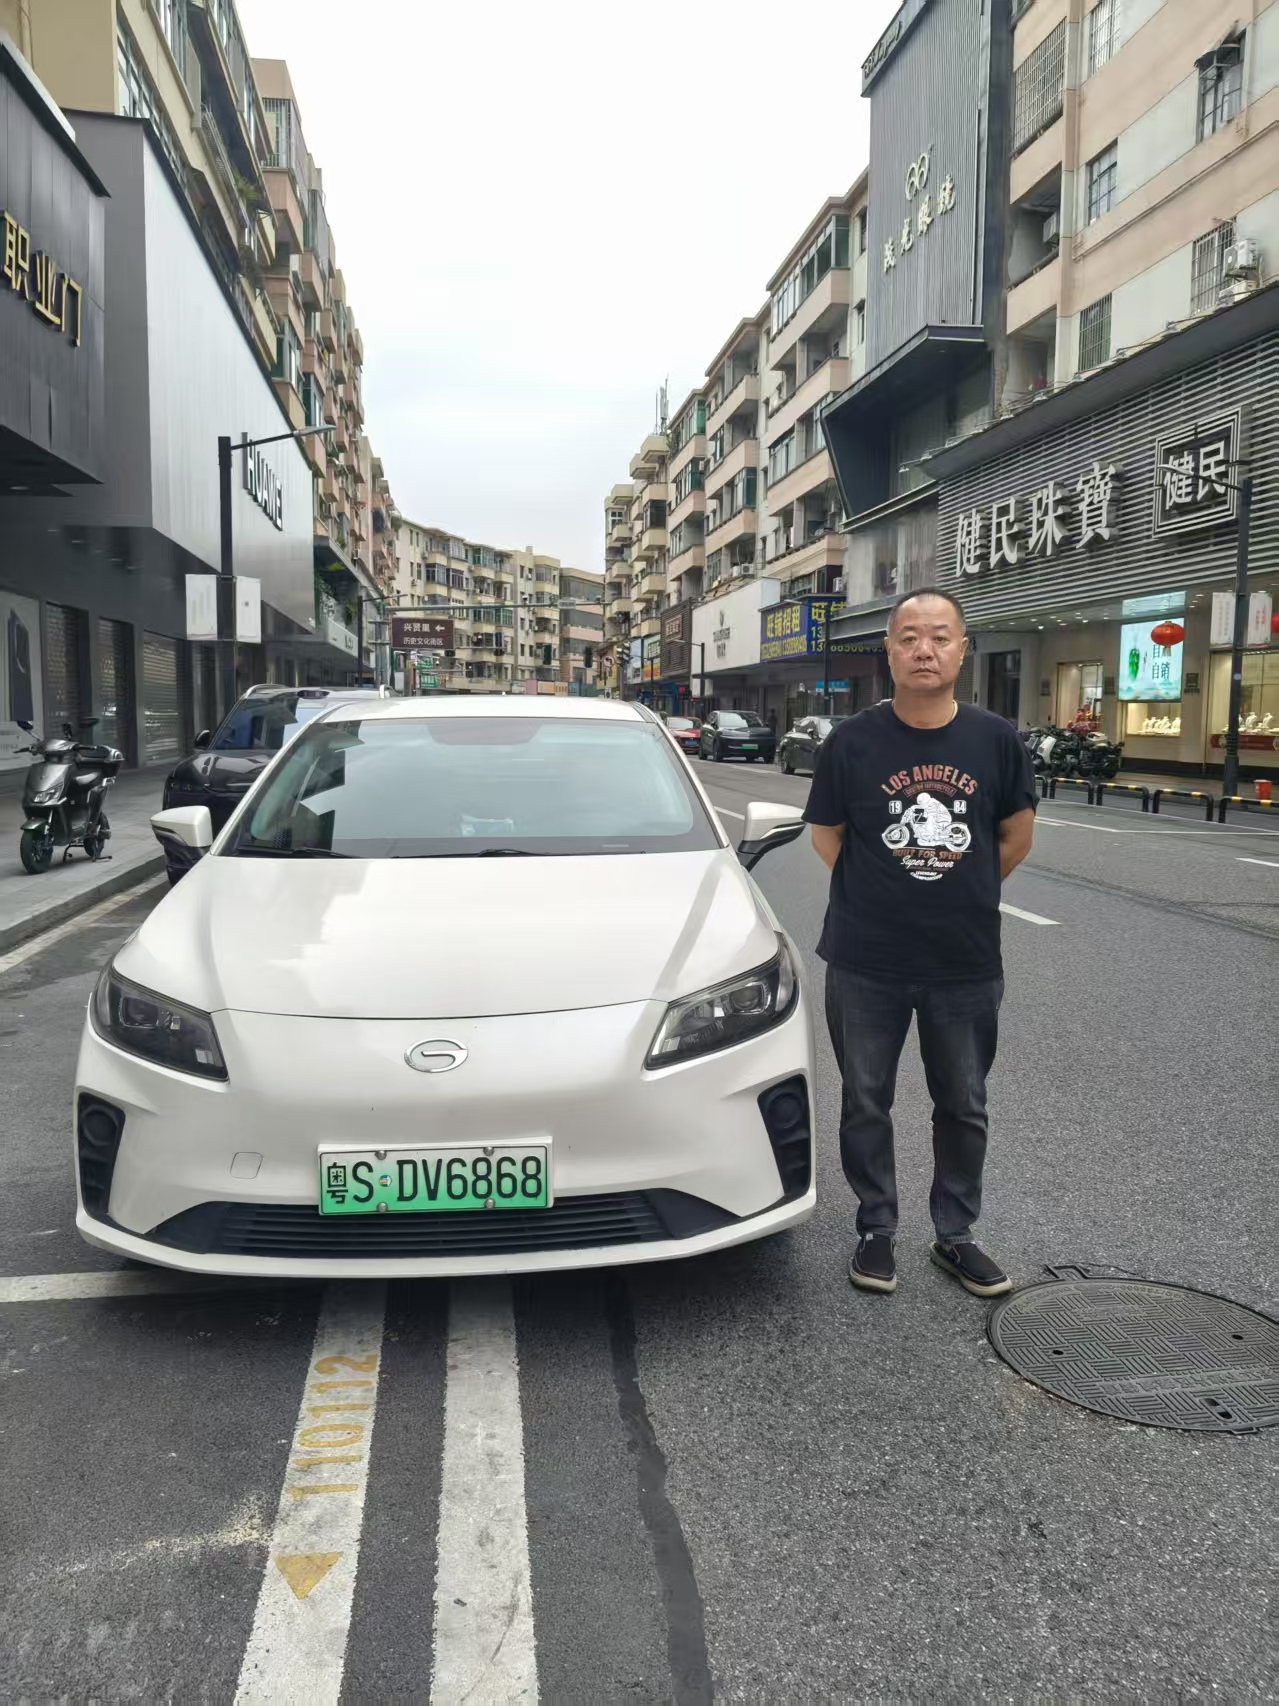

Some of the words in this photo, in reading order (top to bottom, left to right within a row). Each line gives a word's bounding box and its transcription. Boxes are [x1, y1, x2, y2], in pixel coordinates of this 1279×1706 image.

[3, 210, 82, 347] 职业门
[1163, 439, 1230, 511] 健民
[955, 462, 1119, 578] 健民珠寶
[403, 637, 443, 647] 历史文化街区
[1152, 662, 1169, 680] 自销
[881, 770, 910, 795] LOS
[912, 764, 978, 795] ANGELES
[890, 801, 900, 812] 19
[954, 801, 965, 812] 84
[892, 848, 915, 856] BUILT
[919, 849, 935, 858] FOR
[939, 851, 962, 860] SPEED
[900, 855, 925, 869] Super
[927, 857, 954, 868] Power
[396, 1156, 542, 1202] DV6868
